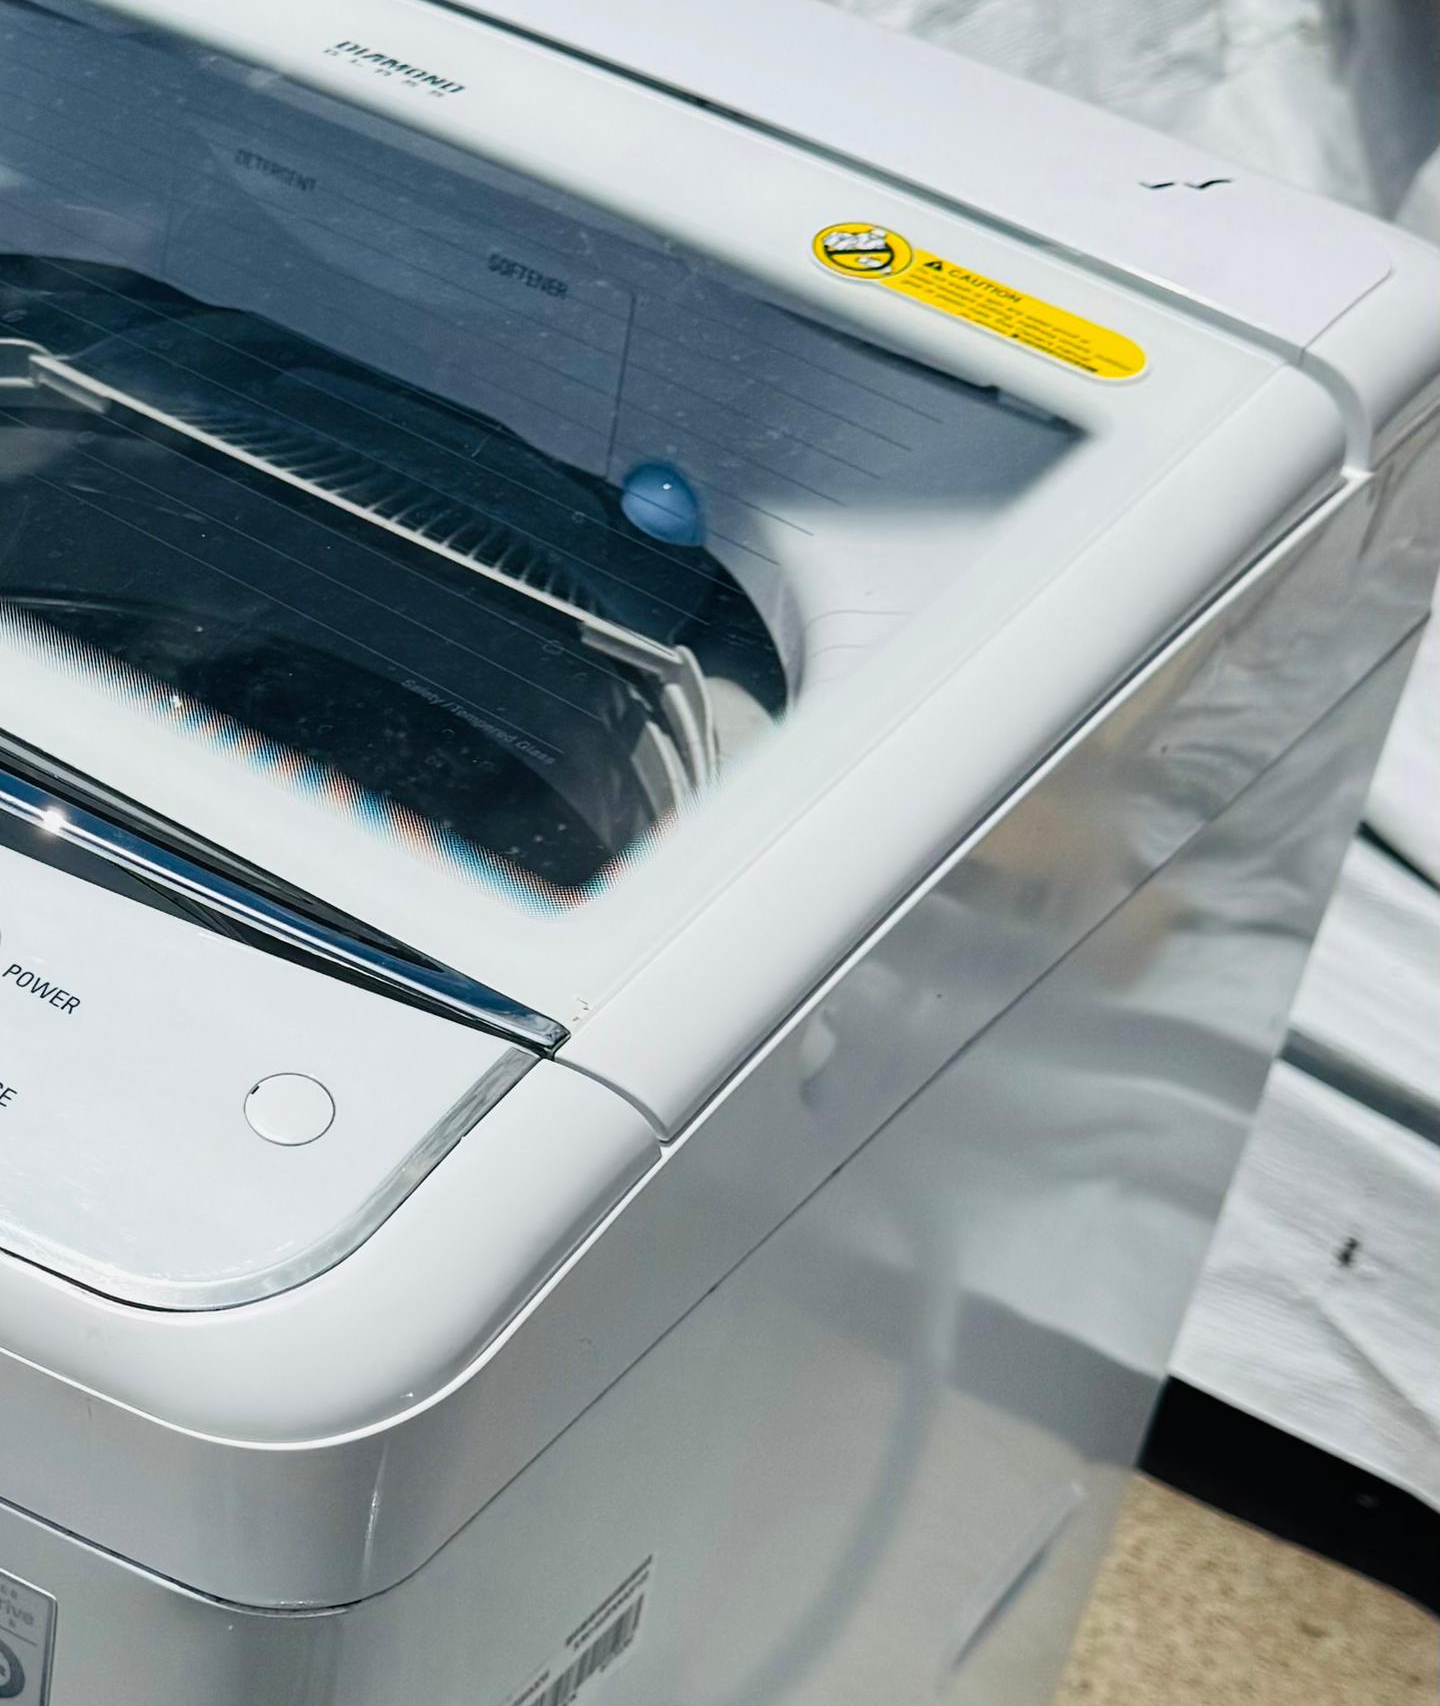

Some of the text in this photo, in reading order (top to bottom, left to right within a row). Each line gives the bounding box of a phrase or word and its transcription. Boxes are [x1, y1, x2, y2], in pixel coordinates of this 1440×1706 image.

[335, 40, 466, 93] DIAMOND
[947, 268, 1023, 304] CAUTION
[2, 961, 83, 1015] POWER
